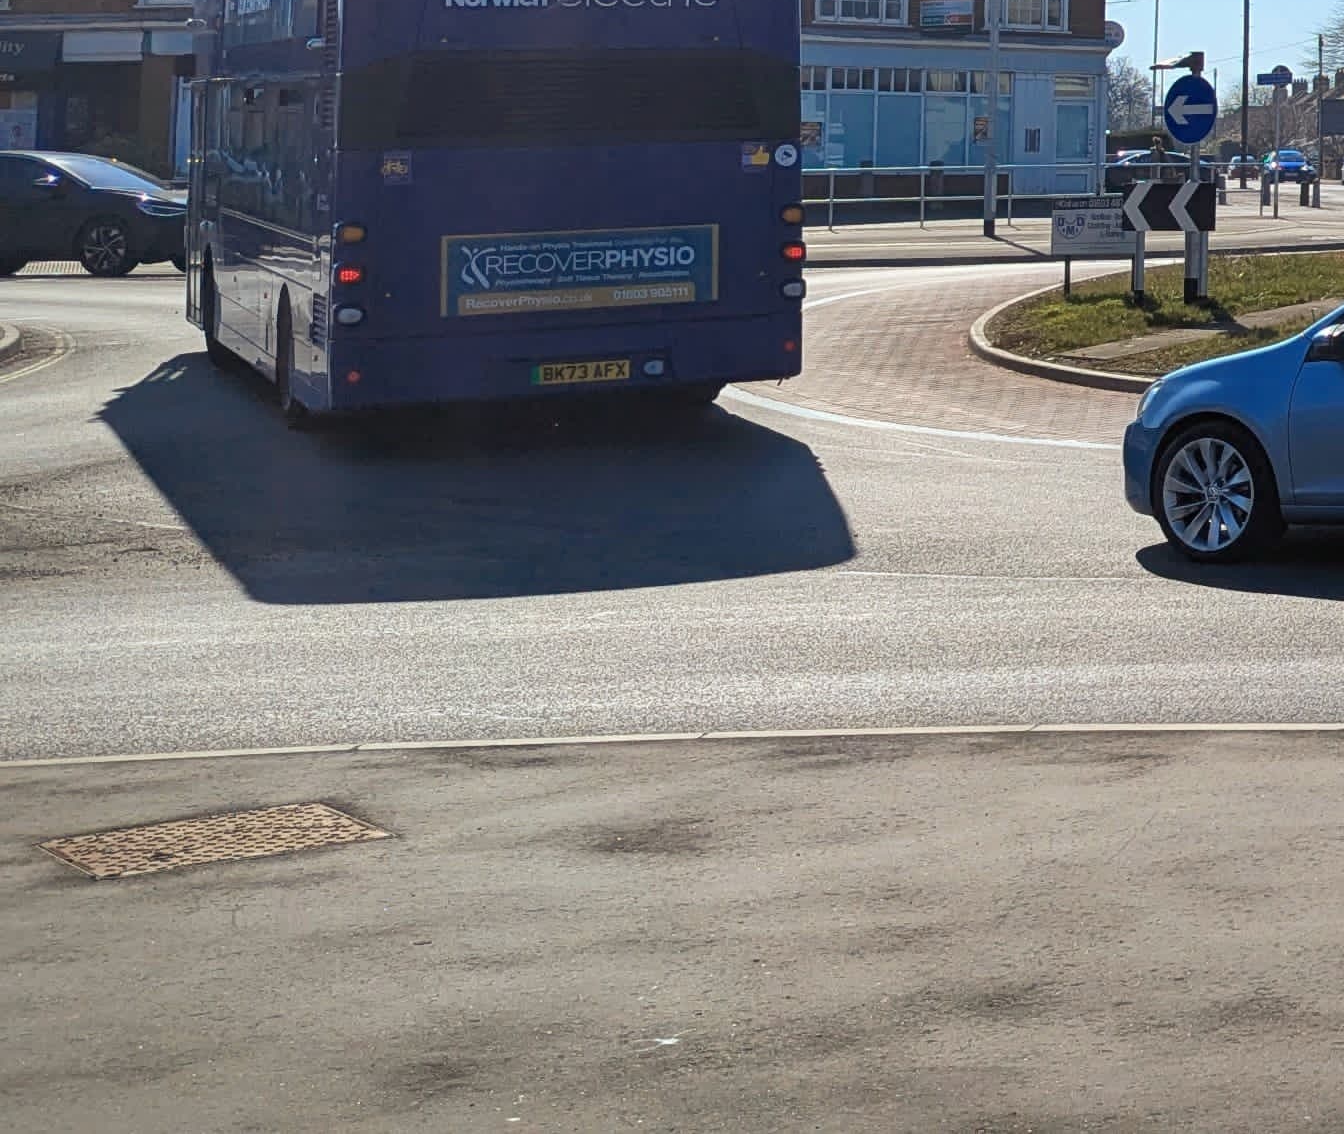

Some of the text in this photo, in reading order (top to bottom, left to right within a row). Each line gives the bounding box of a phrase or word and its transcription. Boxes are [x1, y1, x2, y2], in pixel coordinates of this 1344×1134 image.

[485, 245, 696, 276] RECOVERPHYSIO
[543, 361, 628, 381] BK73 AFX
